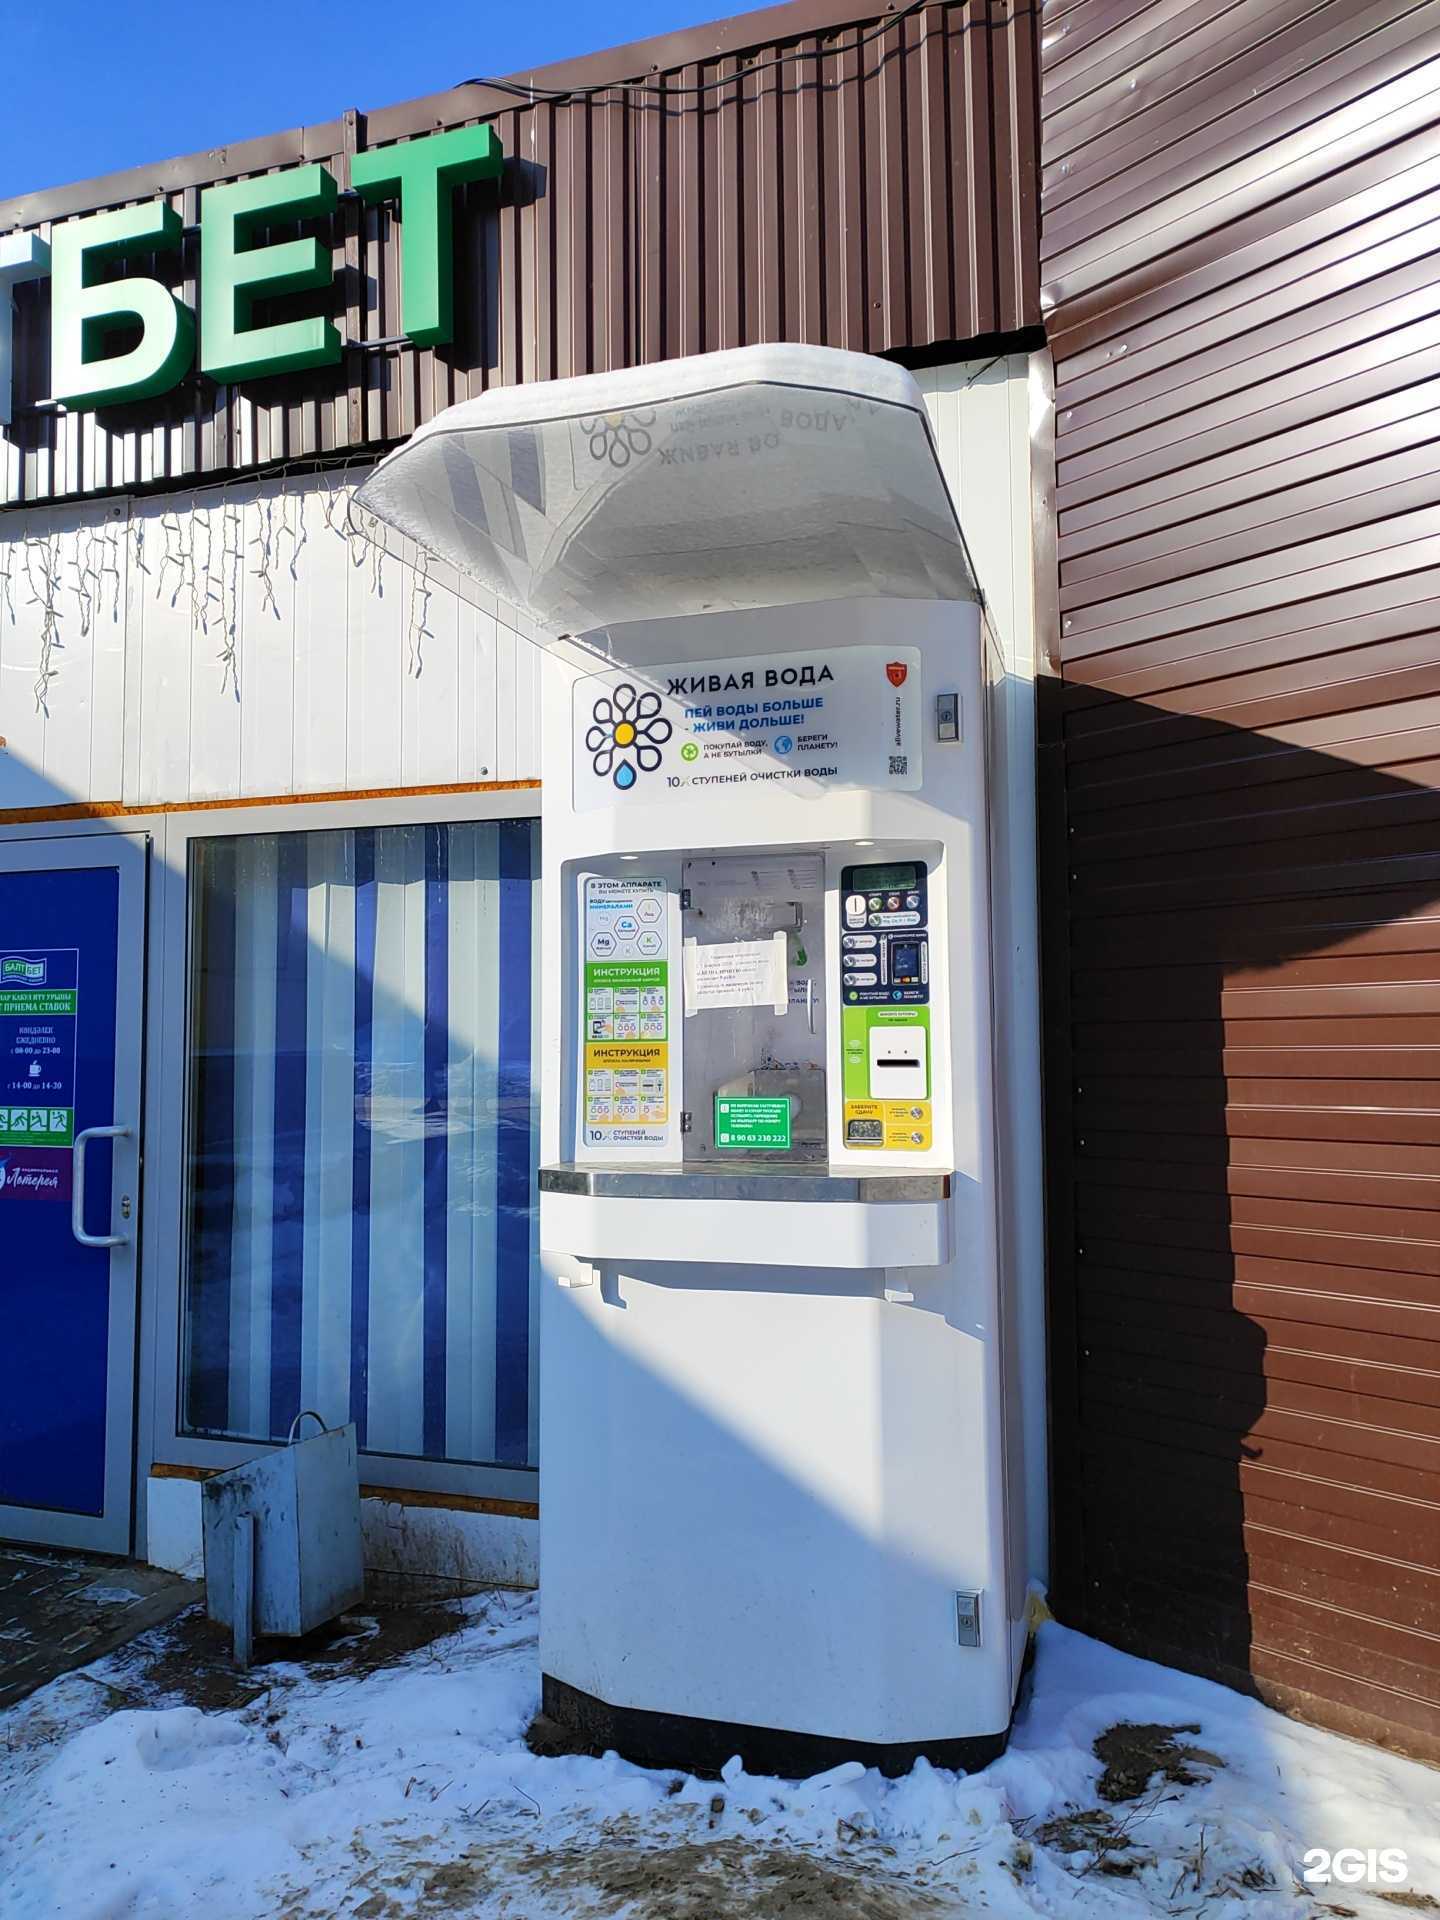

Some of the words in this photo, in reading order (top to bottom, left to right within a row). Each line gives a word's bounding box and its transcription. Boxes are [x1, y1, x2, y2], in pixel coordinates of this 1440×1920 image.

[667, 671, 754, 696] ЖИВАЯ
[765, 664, 835, 687] ВОДА
[684, 705, 712, 718] ПЕЙ
[716, 703, 758, 717] ВОДЫ
[762, 697, 824, 713] БОЛЬШЕ
[693, 719, 735, 733] ЖИВИ
[738, 714, 805, 731] ДОЛЬШЕ!
[797, 734, 828, 743] БЕРЕГИ
[703, 742, 742, 751] ПОКУПАЙ
[797, 742, 839, 751] ПЛАНЕТУ!
[723, 748, 763, 758] БУТЫЛКИ
[692, 773, 747, 785] СТУПЕНЕЙ
[749, 769, 801, 781] ОЧИСТКИ
[804, 766, 838, 777] ВОДЫ
[593, 967, 660, 977] ИНСТРУКЦИЯ
[39, 1002, 71, 1011] СТАВОК
[593, 1048, 661, 1057] ИНСТРУКЦИЯ
[6, 1167, 59, 1191] Лотерея
